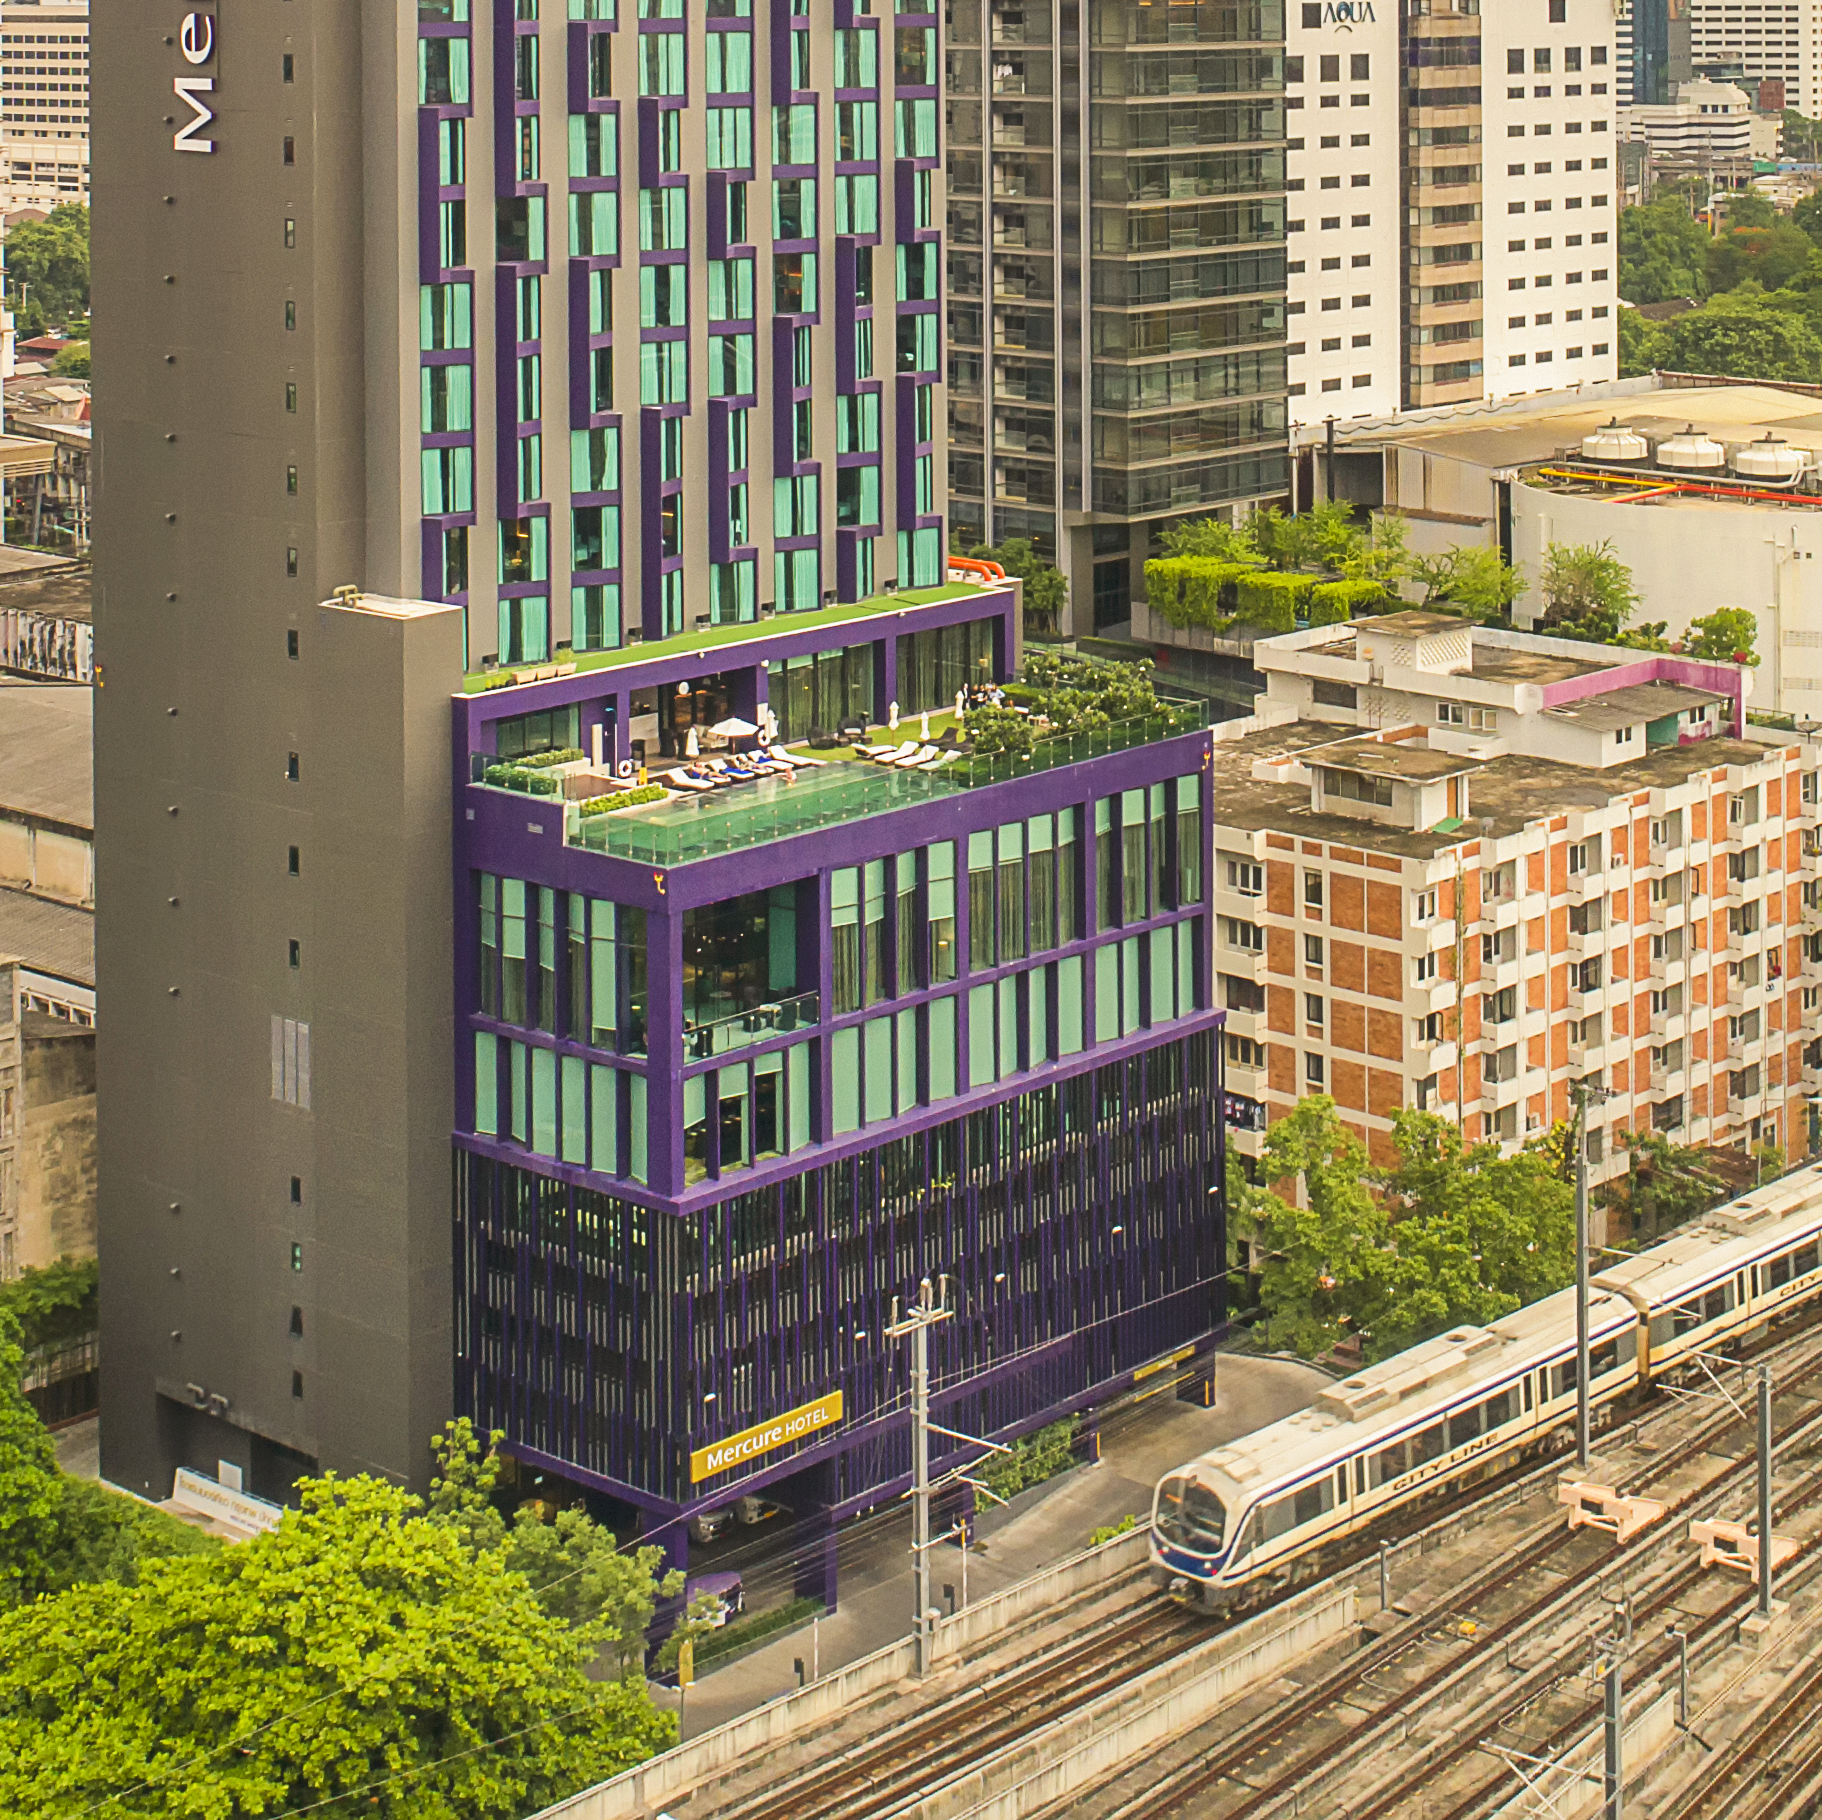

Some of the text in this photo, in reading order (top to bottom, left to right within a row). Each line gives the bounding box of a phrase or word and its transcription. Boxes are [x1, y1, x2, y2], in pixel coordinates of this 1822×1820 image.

[1780, 1273, 1817, 1297] CITY
[706, 1407, 830, 1471] Mercure HOTEL
[1393, 1432, 1498, 1490] CITY LINE
